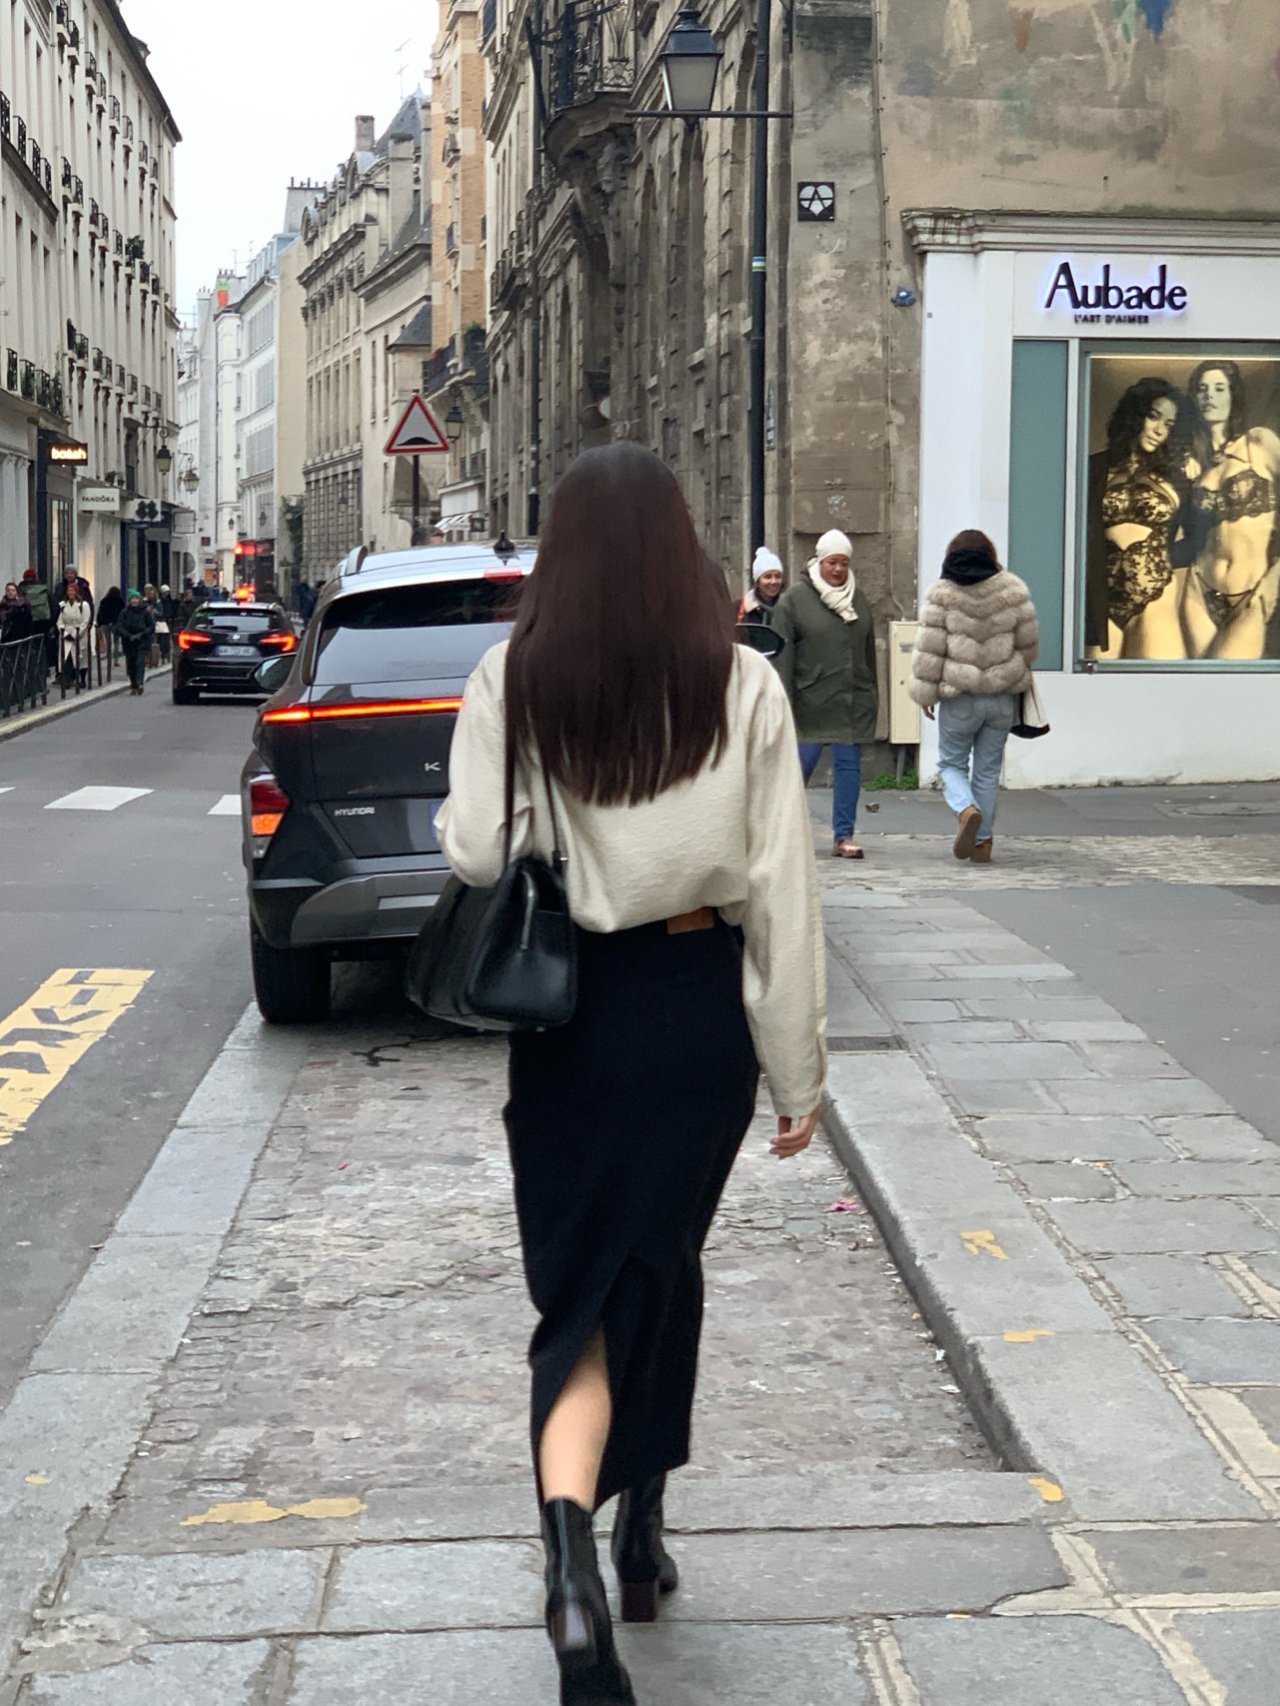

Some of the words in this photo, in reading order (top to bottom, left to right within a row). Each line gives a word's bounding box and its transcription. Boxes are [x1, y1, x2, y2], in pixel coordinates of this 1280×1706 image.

[1044, 261, 1187, 311] Aubade
[1074, 314, 1101, 323] L'ART
[1105, 315, 1149, 324] D'AIMER
[334, 807, 376, 816] HYUNDAI
